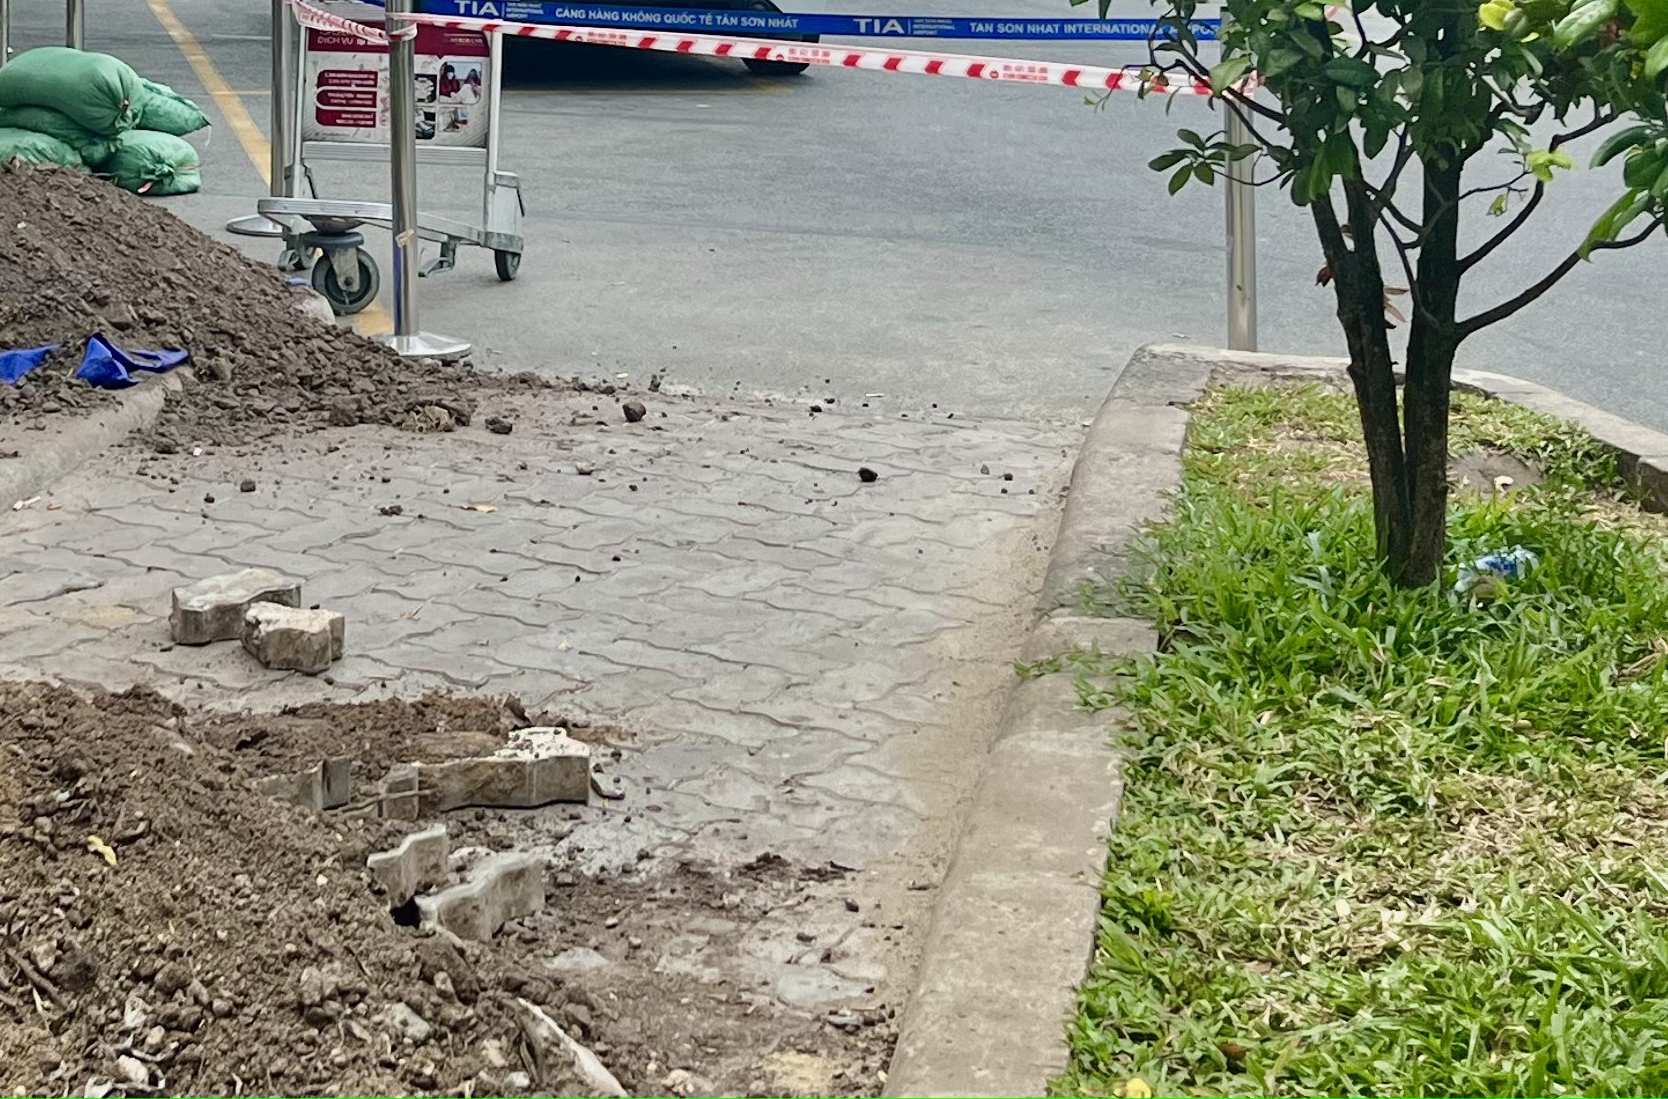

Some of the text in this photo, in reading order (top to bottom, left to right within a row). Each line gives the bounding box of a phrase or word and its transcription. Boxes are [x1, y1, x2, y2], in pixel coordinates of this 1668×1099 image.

[454, 0, 499, 16] TIA
[852, 18, 905, 34] TIA
[969, 22, 994, 33] TAN
[997, 22, 1025, 34] SON
[1027, 22, 1060, 34] NHAT
